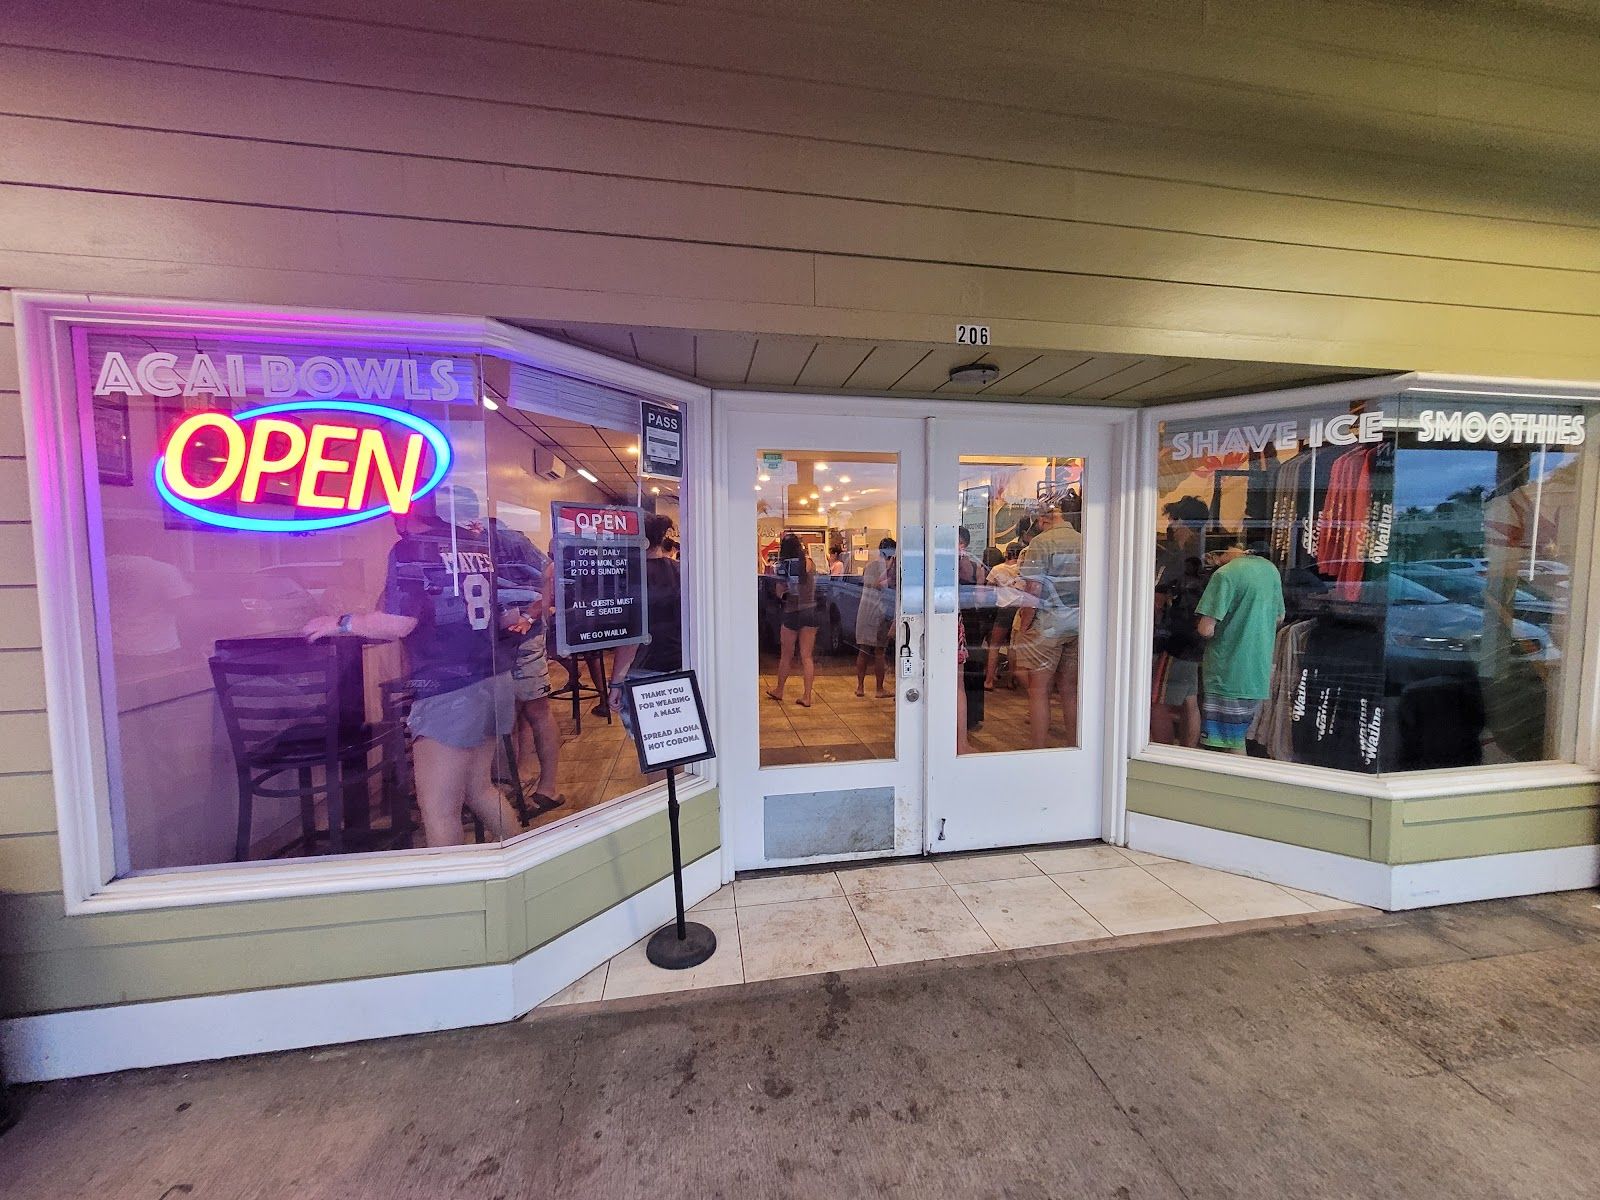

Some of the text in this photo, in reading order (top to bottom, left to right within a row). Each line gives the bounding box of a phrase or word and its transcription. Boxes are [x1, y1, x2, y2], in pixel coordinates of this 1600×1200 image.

[958, 326, 988, 345] 206
[94, 351, 460, 401] ACAI BOWLS
[648, 413, 678, 430] PASS
[1417, 409, 1586, 446] SMOOTHIES
[1171, 411, 1384, 461] SHAVE ICE
[164, 412, 424, 514] OPEN
[576, 513, 627, 531] OPEN
[1372, 503, 1394, 564] Wailua
[571, 568, 625, 576] 12 TO 6 SUNDAY
[463, 574, 491, 631] 8
[572, 597, 634, 609] ALL GUESTS MUST
[585, 606, 623, 617] BE SEATED
[580, 628, 628, 641] WE GO WAILUA
[640, 690, 666, 699] THANK
[638, 696, 690, 710] FOR WEARING
[660, 707, 681, 716] MASK
[643, 724, 699, 740] SPREAD ALOHA
[648, 735, 699, 750] NOT CORONA
